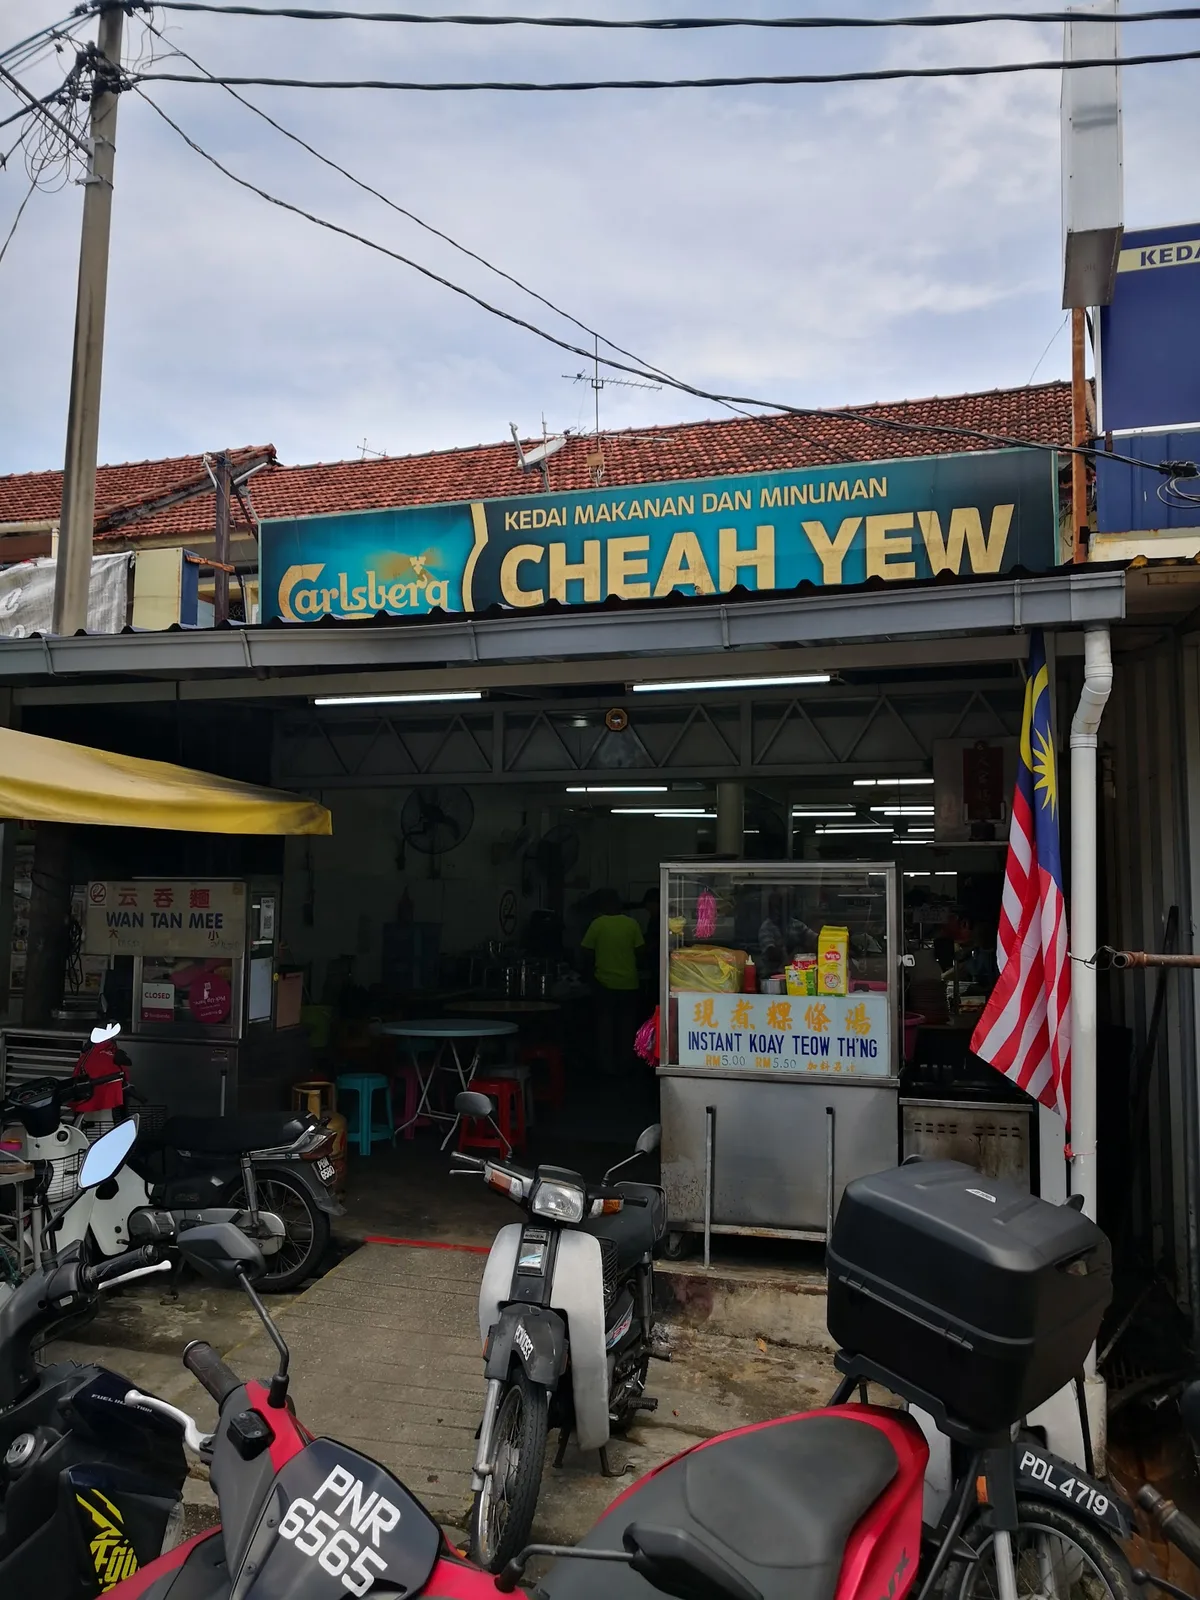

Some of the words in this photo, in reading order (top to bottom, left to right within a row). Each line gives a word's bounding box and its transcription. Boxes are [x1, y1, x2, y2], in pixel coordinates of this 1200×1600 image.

[504, 506, 567, 532] KEDAI
[574, 495, 695, 525] MAKANAN
[702, 489, 752, 513] DAN
[760, 476, 888, 508] MINUMAN
[500, 524, 776, 609] CHEAH
[801, 504, 1015, 585] YEW
[278, 562, 450, 622] Carlsberg
[106, 911, 144, 928] WAN
[150, 912, 183, 929] TAN
[188, 912, 224, 929] MEE
[118, 887, 211, 909] 云吞麵
[108, 929, 119, 939] 大
[208, 930, 219, 941] 小
[144, 991, 171, 1000] CLOSED
[688, 1031, 743, 1052] INSTANT
[749, 1033, 785, 1054] KOAY
[791, 1035, 831, 1056] TEOW
[837, 1037, 878, 1058] TH'NG
[312, 1463, 402, 1548] PNR
[1019, 1451, 1058, 1491] PDL
[1058, 1477, 1110, 1516] 4719
[278, 1497, 389, 1598] 6565
